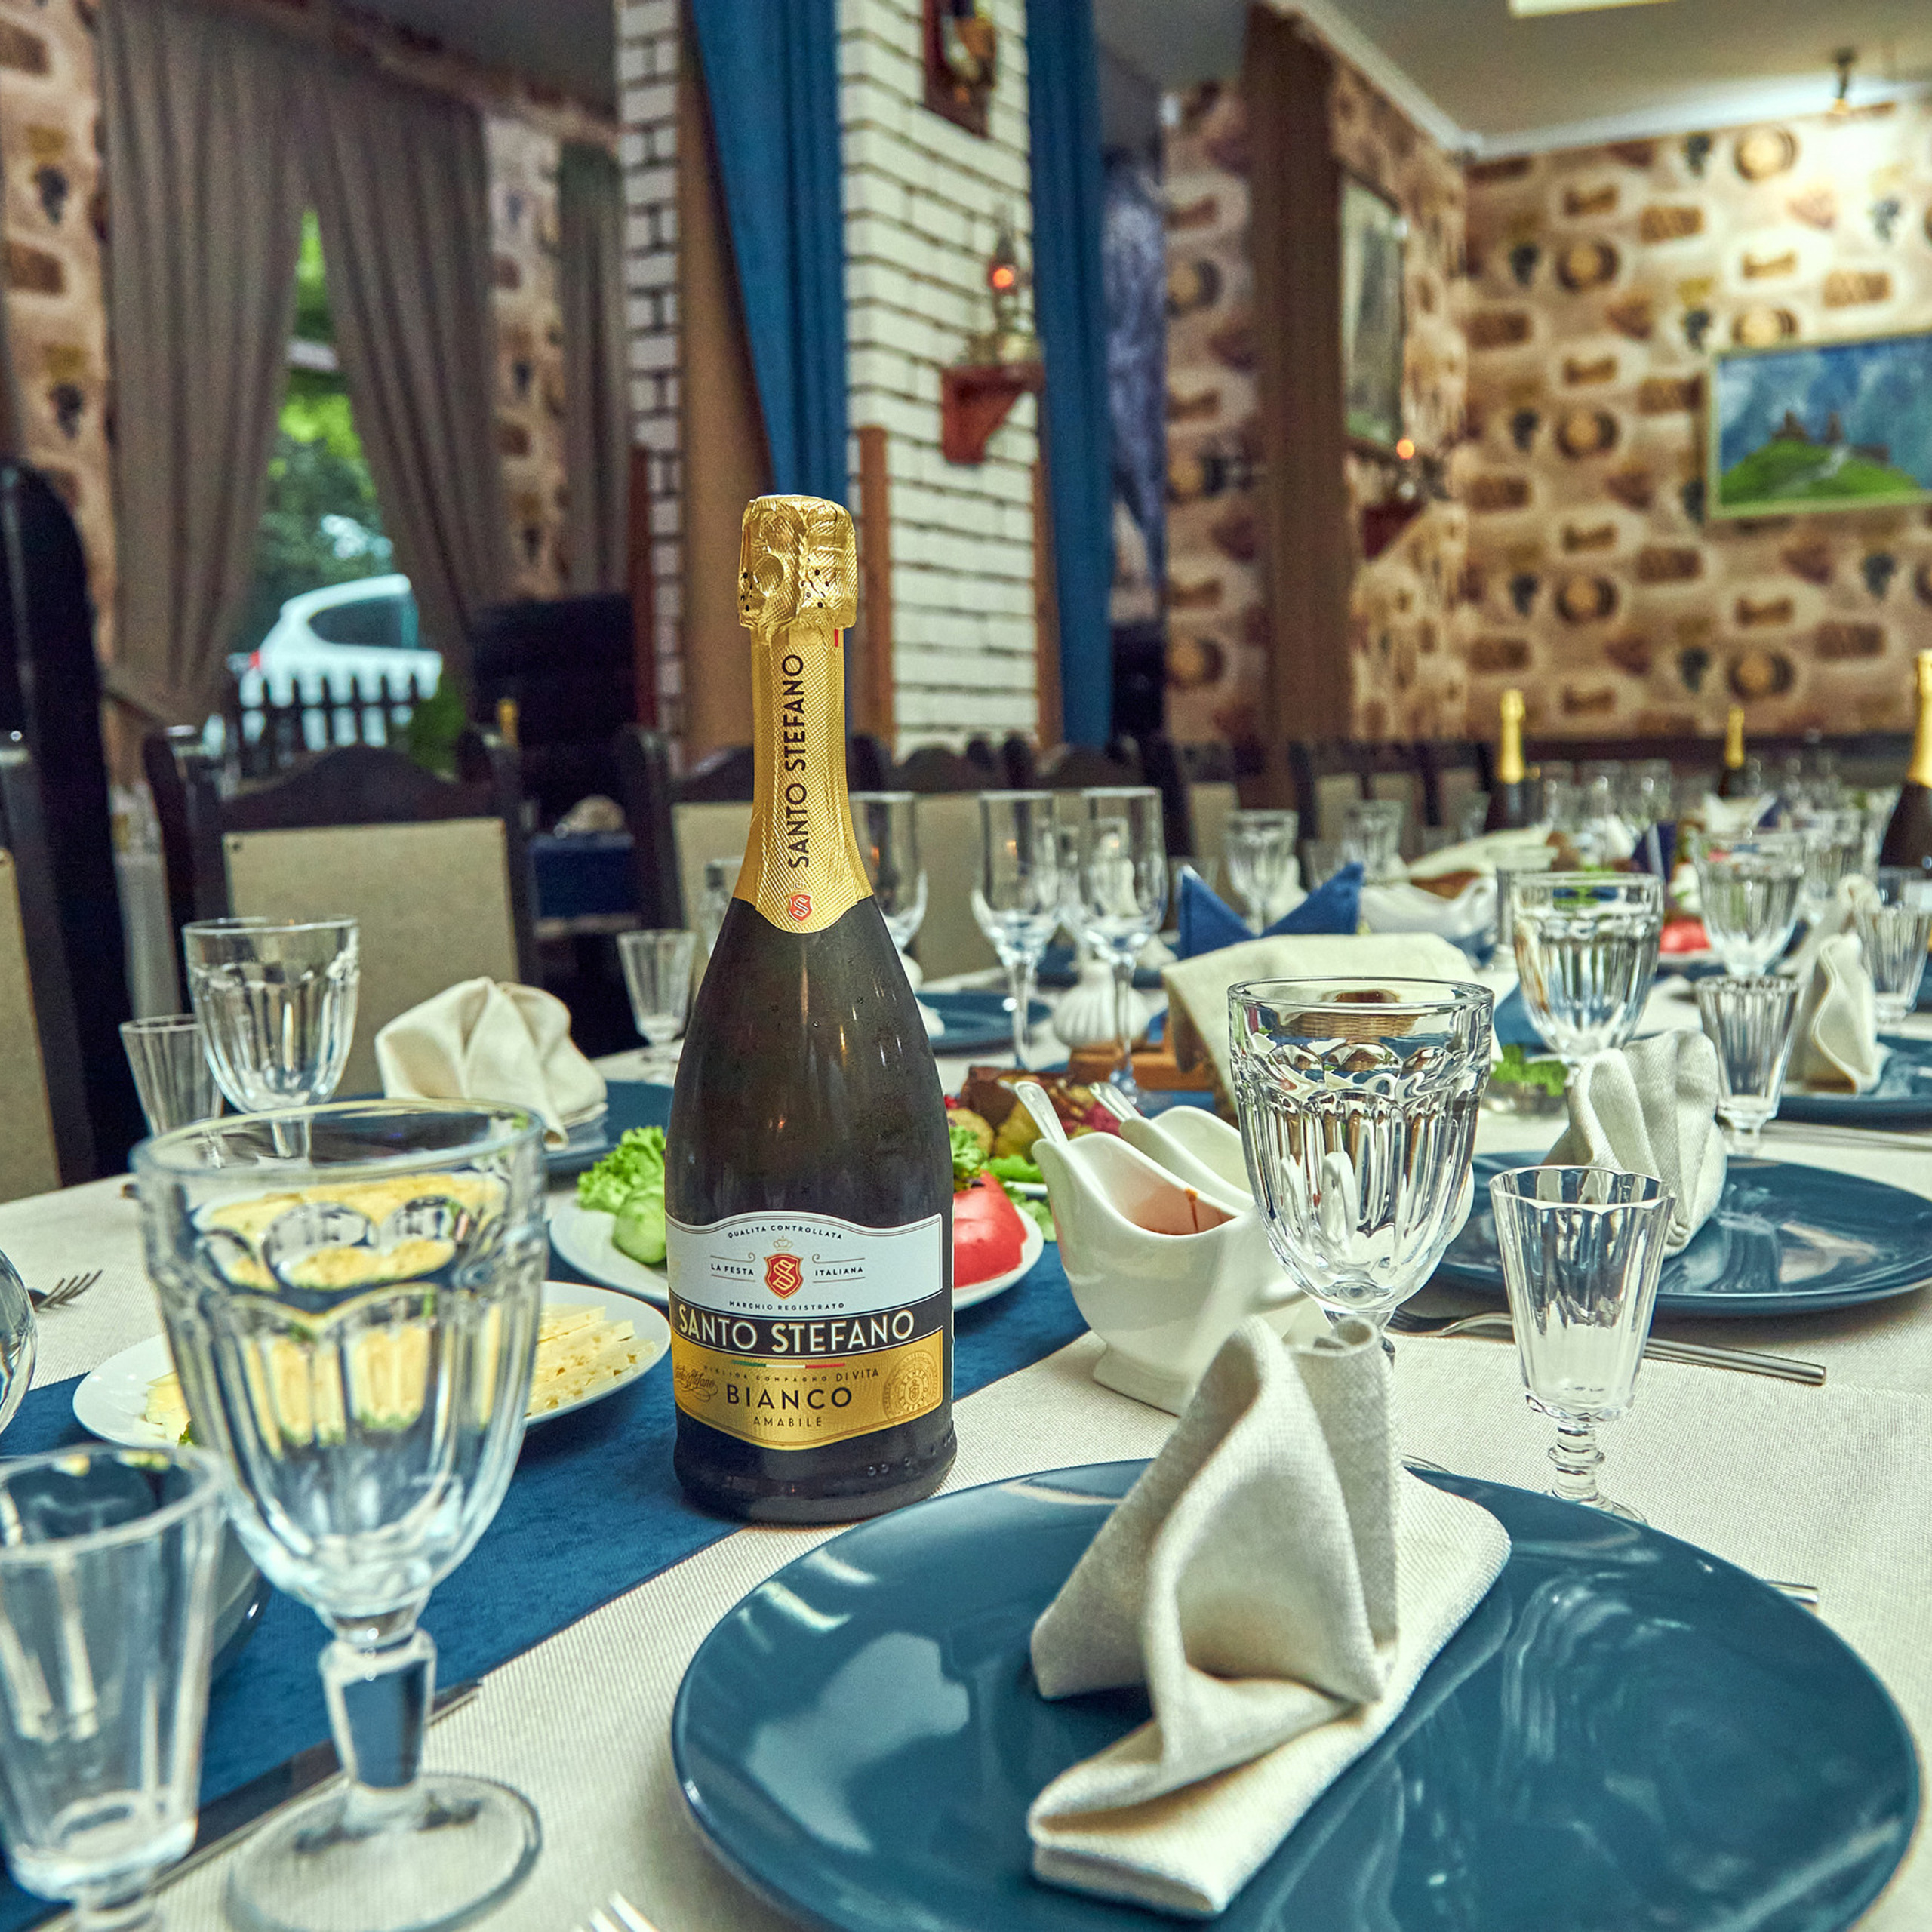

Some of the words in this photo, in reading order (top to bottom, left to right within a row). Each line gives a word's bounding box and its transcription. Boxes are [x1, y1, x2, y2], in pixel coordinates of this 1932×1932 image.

[782, 654, 806, 771] STEFANO
[786, 783, 809, 868] SANTO
[728, 1226, 767, 1239] QUALITA
[771, 1225, 842, 1240] CONTROLLATA
[710, 1263, 721, 1272] LA
[724, 1266, 754, 1275] FESTA
[815, 1266, 863, 1276] ITALIANA
[729, 1300, 773, 1310] MARCHIO
[778, 1303, 845, 1311] REGISTRATO
[678, 1303, 758, 1350] SANTO
[771, 1309, 915, 1354] STEFANO
[852, 1367, 879, 1380] VITA
[727, 1384, 852, 1410] BIANCO
[753, 1416, 822, 1427] AMABILE
